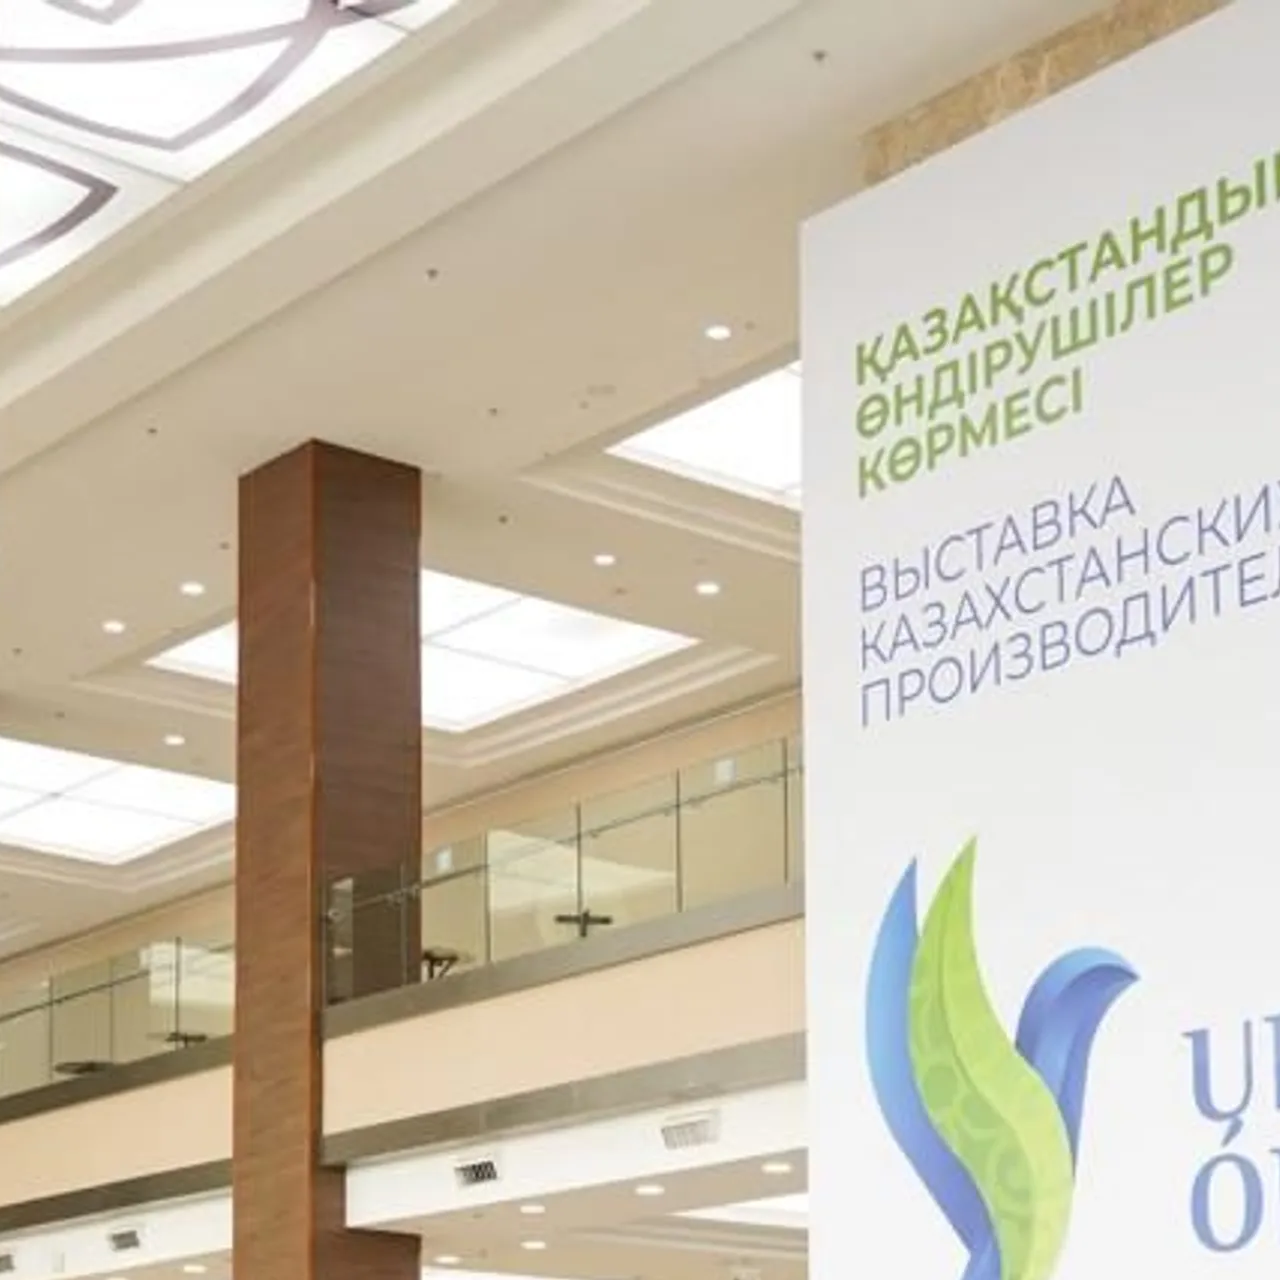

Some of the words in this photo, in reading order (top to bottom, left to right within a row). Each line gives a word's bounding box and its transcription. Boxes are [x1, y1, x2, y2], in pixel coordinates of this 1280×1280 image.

[856, 243, 1234, 439] ӨНДІРУШІЛЕР
[858, 368, 1083, 497] КӨРМЕСІ
[861, 474, 1136, 612] ВЫСТАВКА
